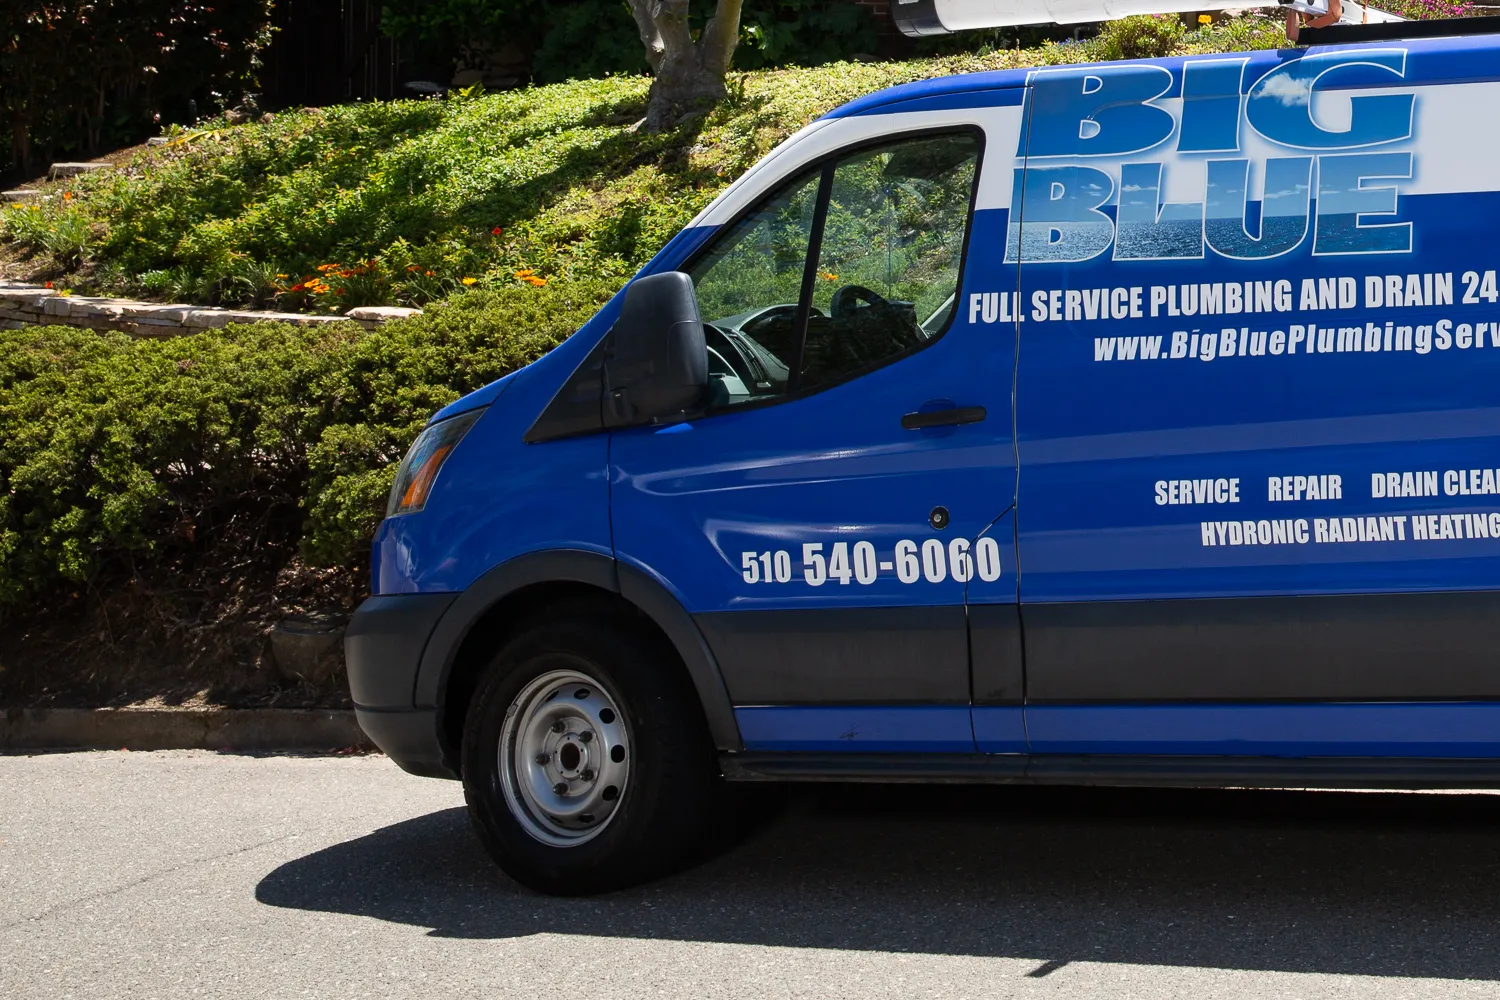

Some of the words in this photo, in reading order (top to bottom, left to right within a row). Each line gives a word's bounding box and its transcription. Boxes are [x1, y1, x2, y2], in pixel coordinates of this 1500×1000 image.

[1014, 48, 1418, 158] BIG
[1002, 151, 1414, 265] BLUE
[968, 291, 1025, 324] FULL
[1031, 286, 1143, 322] SERVICE
[1150, 279, 1293, 317] PLUMBING
[1299, 277, 1363, 311] AND
[1364, 271, 1454, 308] DRAIN
[1461, 270, 1499, 304] 24
[1154, 477, 1240, 506] SERVICE
[1268, 474, 1343, 502] REPAIR
[1371, 470, 1438, 498] DRAIN
[1200, 520, 1310, 547] HYDRONIC
[1314, 515, 1408, 544] RADIANT
[742, 550, 792, 584] 510
[802, 537, 1001, 587] 540-6060
